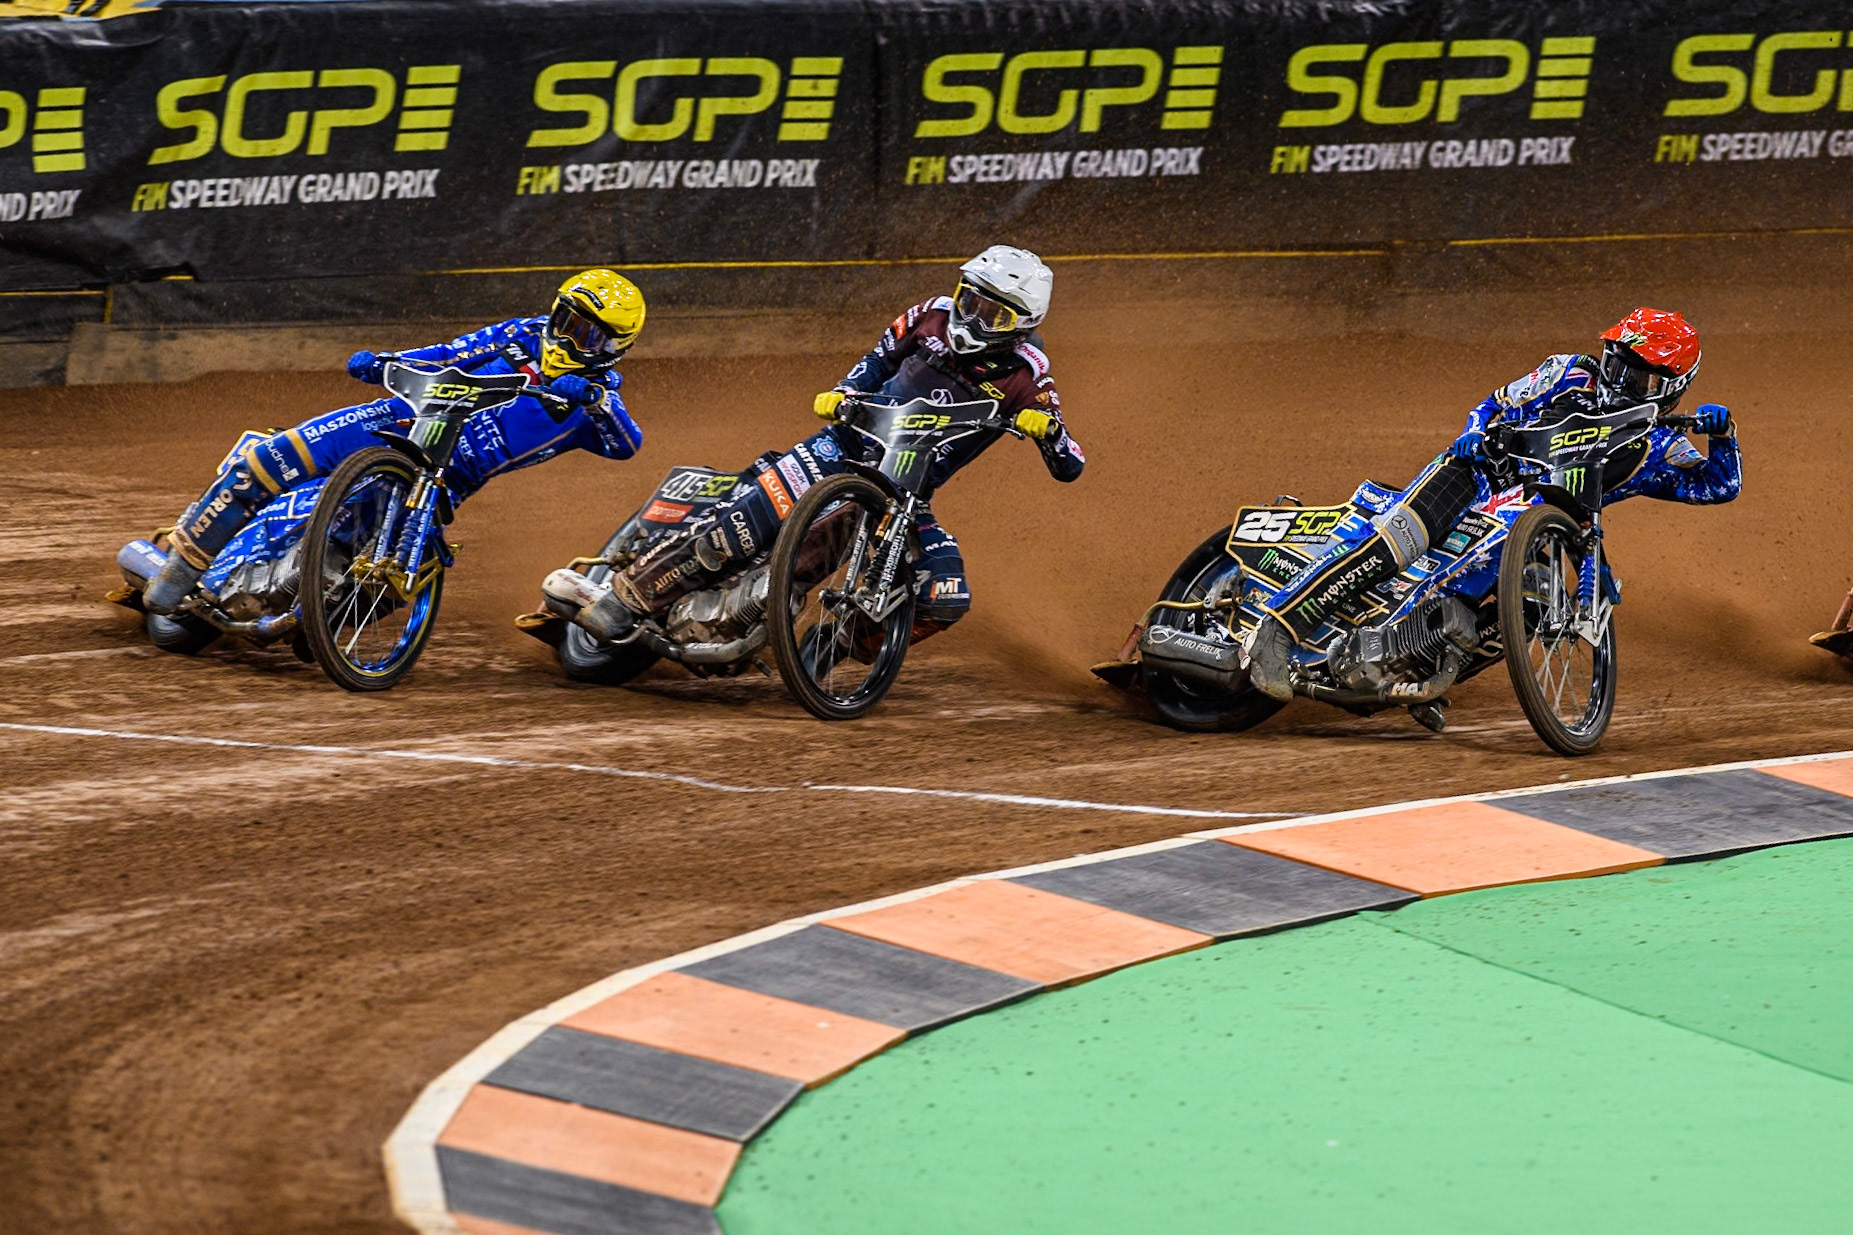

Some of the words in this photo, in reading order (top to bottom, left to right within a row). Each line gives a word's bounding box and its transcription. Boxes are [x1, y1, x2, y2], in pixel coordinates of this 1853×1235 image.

[1662, 30, 1853, 117] SG
[1269, 145, 1311, 174] FIM
[1311, 140, 1429, 173] SPEEDWAY
[1428, 138, 1514, 168] GRAND
[1517, 136, 1576, 166] PRIX
[1654, 134, 1699, 163] FIM
[1700, 130, 1826, 162] SPEEDWAY
[516, 165, 561, 195] FIM
[563, 160, 683, 193] SPEEDWAY
[682, 159, 764, 189] GRAND
[764, 158, 821, 188] PRIX
[904, 156, 947, 185] FIM
[948, 151, 1071, 184] SPEEDWAY
[1072, 149, 1148, 178] GRAND
[1149, 147, 1204, 176] PRIX
[27, 189, 82, 221] PRIX
[131, 181, 170, 212] FIM
[168, 174, 299, 209] SPEEDWAY
[298, 171, 380, 203] GRAND
[381, 168, 441, 199] PRIX
[763, 473, 789, 514] KUKA
[190, 489, 233, 538] ORLEN
[1234, 511, 1297, 542] 25
[1288, 511, 1341, 535] SGP
[1174, 638, 1196, 650] AUTO
[1196, 643, 1223, 658] FRELIK
